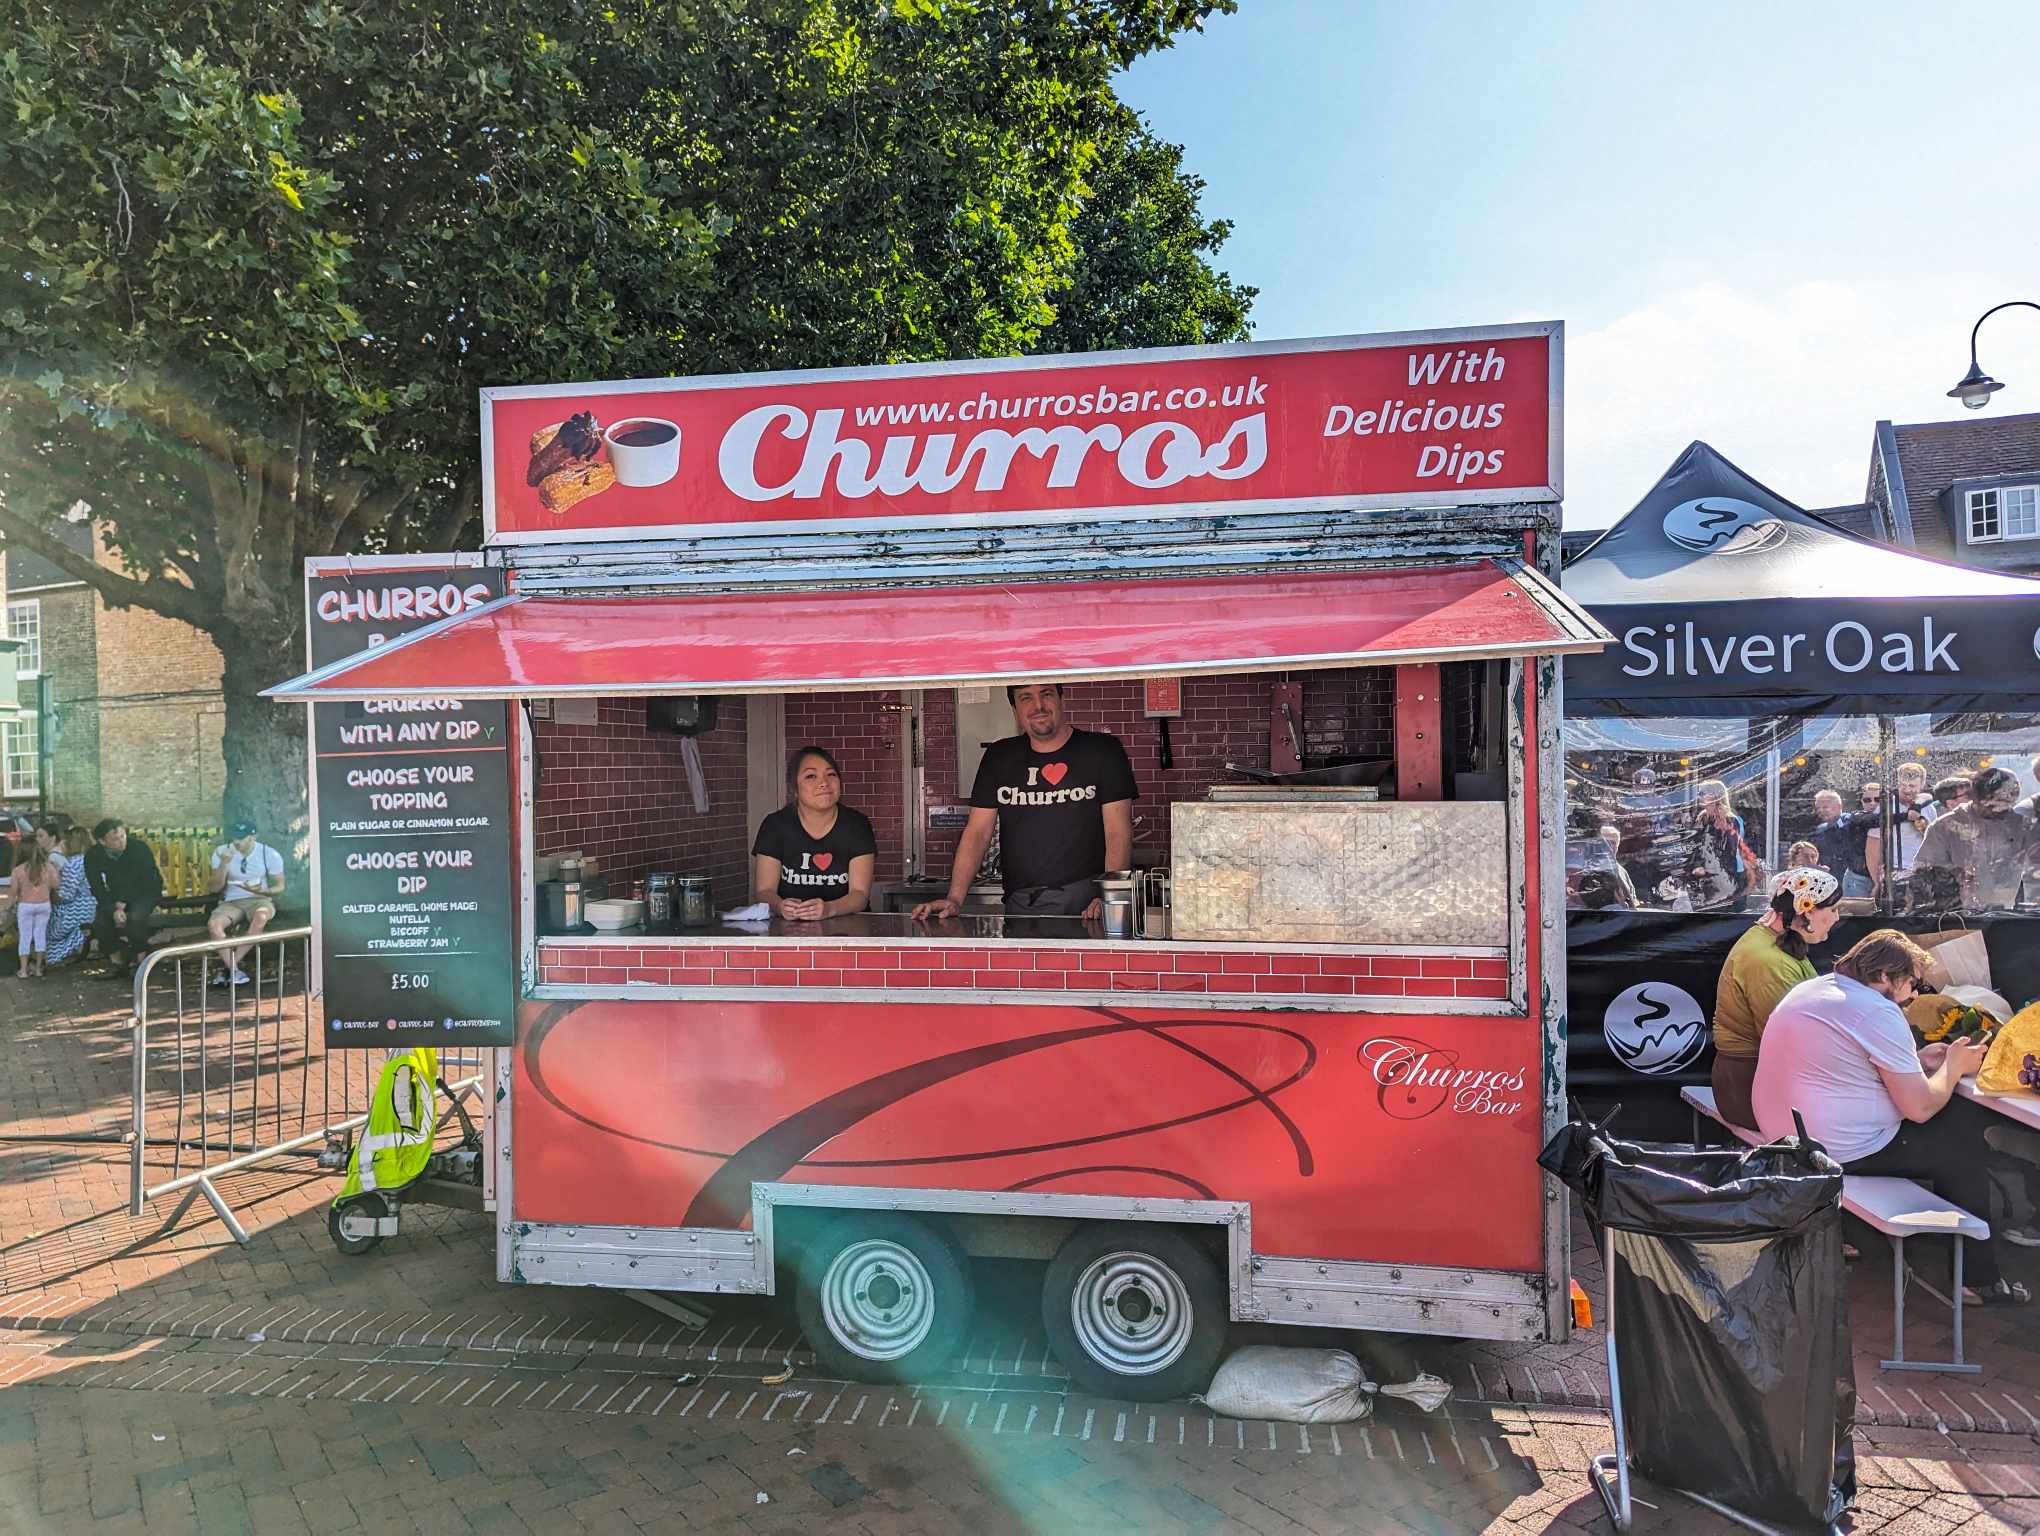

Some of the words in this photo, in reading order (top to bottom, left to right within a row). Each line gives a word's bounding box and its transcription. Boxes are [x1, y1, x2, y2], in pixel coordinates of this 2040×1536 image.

[1408, 347, 1505, 386] With
[855, 375, 1269, 427] www.churrosbar.co.uk
[1323, 399, 1505, 437] Delicious
[718, 404, 1268, 502] Churros
[1416, 442, 1505, 483] Dips
[317, 583, 489, 622] CHURROS
[1621, 621, 1806, 677] Silver
[1825, 616, 1961, 673] Oak
[340, 724, 393, 743] WITH
[397, 721, 440, 742] ANY
[446, 720, 480, 740] DIP
[347, 767, 420, 787] CHOOSE
[423, 765, 475, 784] YOUR
[1026, 766, 1039, 786] I
[369, 791, 448, 811] TOPPING
[997, 785, 1096, 805] Churros
[330, 821, 356, 831] PLAIN
[358, 820, 391, 830] SUGAR
[392, 819, 405, 829] OR
[406, 817, 454, 829] CINNAMON
[346, 851, 419, 870] CHOOSE
[423, 850, 473, 868] YOUR
[800, 852, 812, 870] I
[397, 876, 428, 894] DIP
[342, 904, 375, 914] SALTED
[376, 903, 419, 913] CARAMEL
[389, 914, 431, 924] NUTELLA
[391, 926, 430, 936] BISCOFF
[367, 938, 428, 949] STRAWBERRY
[430, 938, 449, 948] JAM
[391, 973, 430, 990] £5.00
[1363, 1038, 1525, 1093] Churros
[1452, 1085, 1522, 1115] Bar
